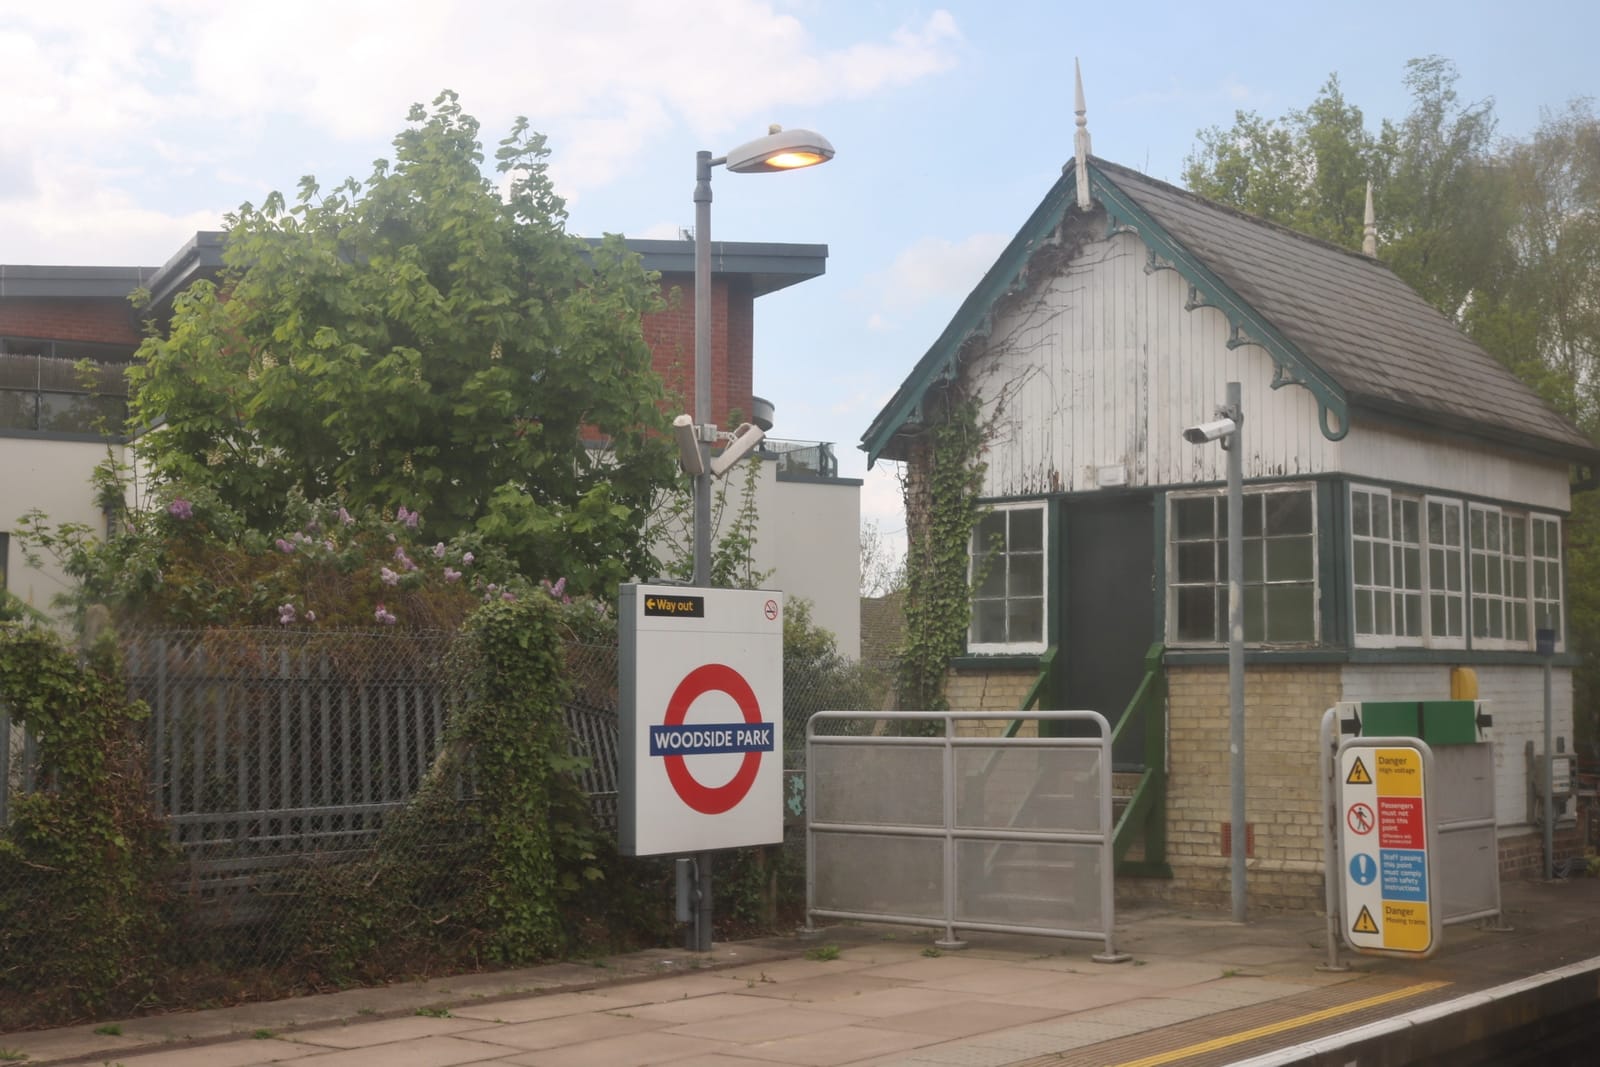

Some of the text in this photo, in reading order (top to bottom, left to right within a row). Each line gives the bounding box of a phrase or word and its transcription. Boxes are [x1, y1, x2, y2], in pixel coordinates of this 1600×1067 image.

[656, 599, 694, 613] Way out
[654, 729, 770, 749] WOODSIDE PARK
[1378, 756, 1407, 766] Danger
[1381, 802, 1414, 810] Passengers
[1400, 855, 1422, 863] passing
[1400, 877, 1418, 885] safety
[1386, 906, 1414, 917] Danger
